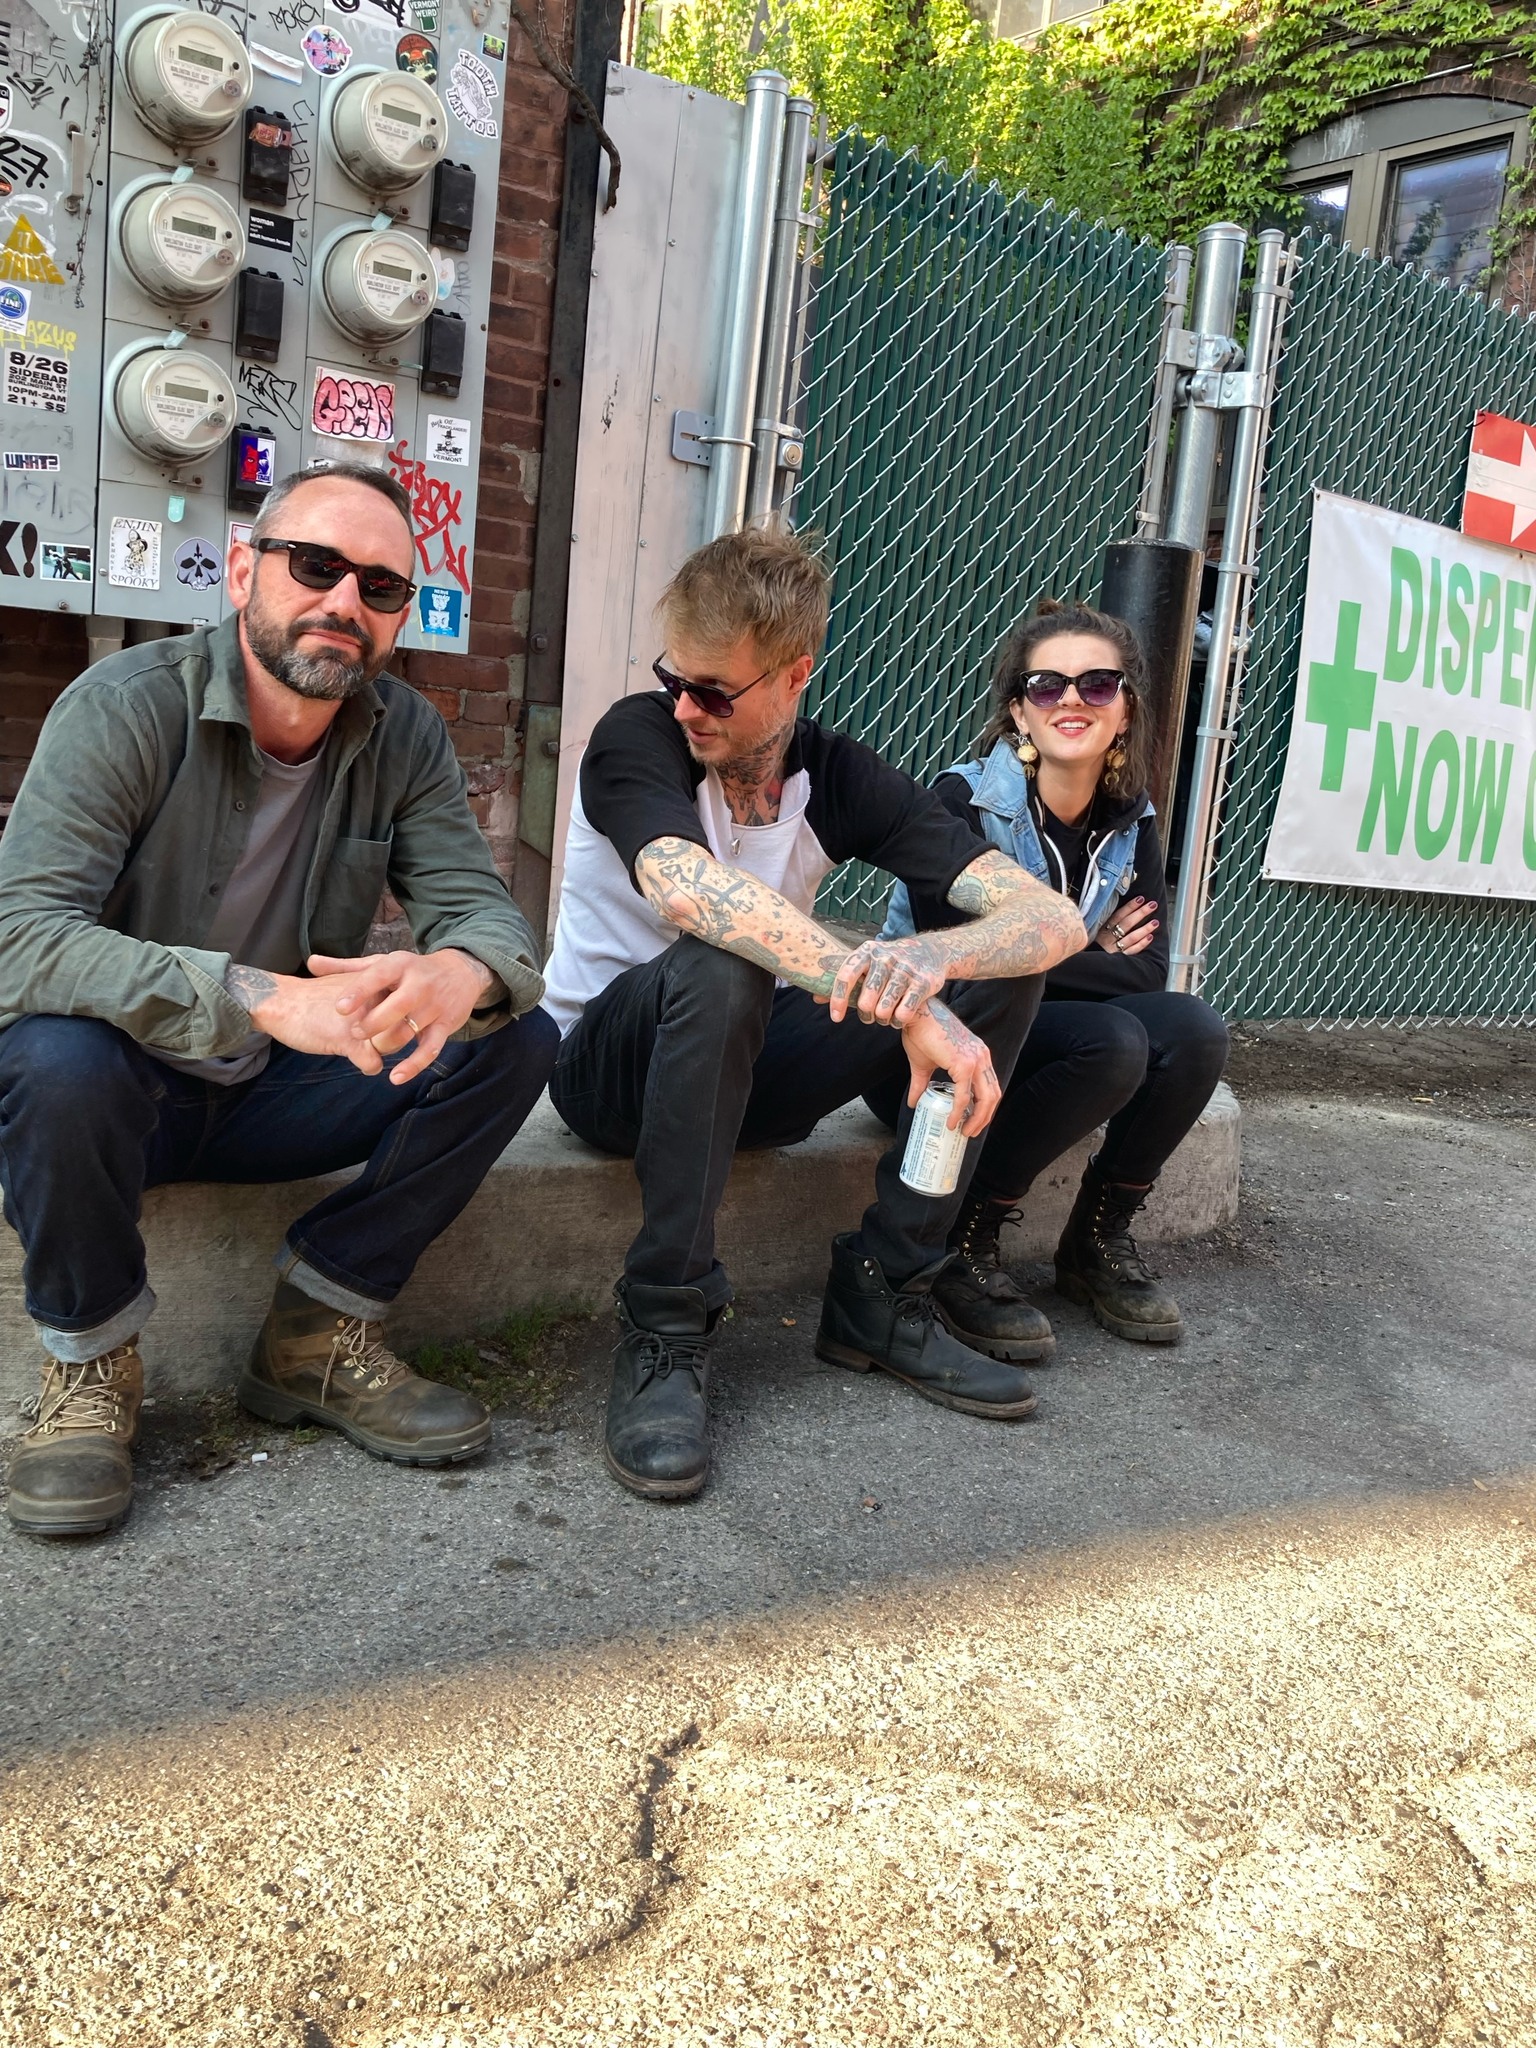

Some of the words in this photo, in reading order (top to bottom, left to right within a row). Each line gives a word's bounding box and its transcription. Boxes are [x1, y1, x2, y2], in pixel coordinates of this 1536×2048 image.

[409, 0, 440, 9] VERMONT
[415, 9, 437, 17] WEIRD
[460, 53, 497, 97] TOOTH
[447, 88, 496, 136] TATTOO
[10, 351, 68, 375] 8/26
[9, 366, 67, 384] SIDEBAR
[9, 374, 27, 382] 202
[30, 378, 52, 387] MAIN
[8, 385, 66, 402] 10PM-2AM
[45, 401, 66, 413] $5
[5, 453, 58, 470] WHAT?
[433, 453, 462, 463] VERMONT
[111, 575, 159, 588] SPOOKY
[1356, 721, 1514, 865] NOW
